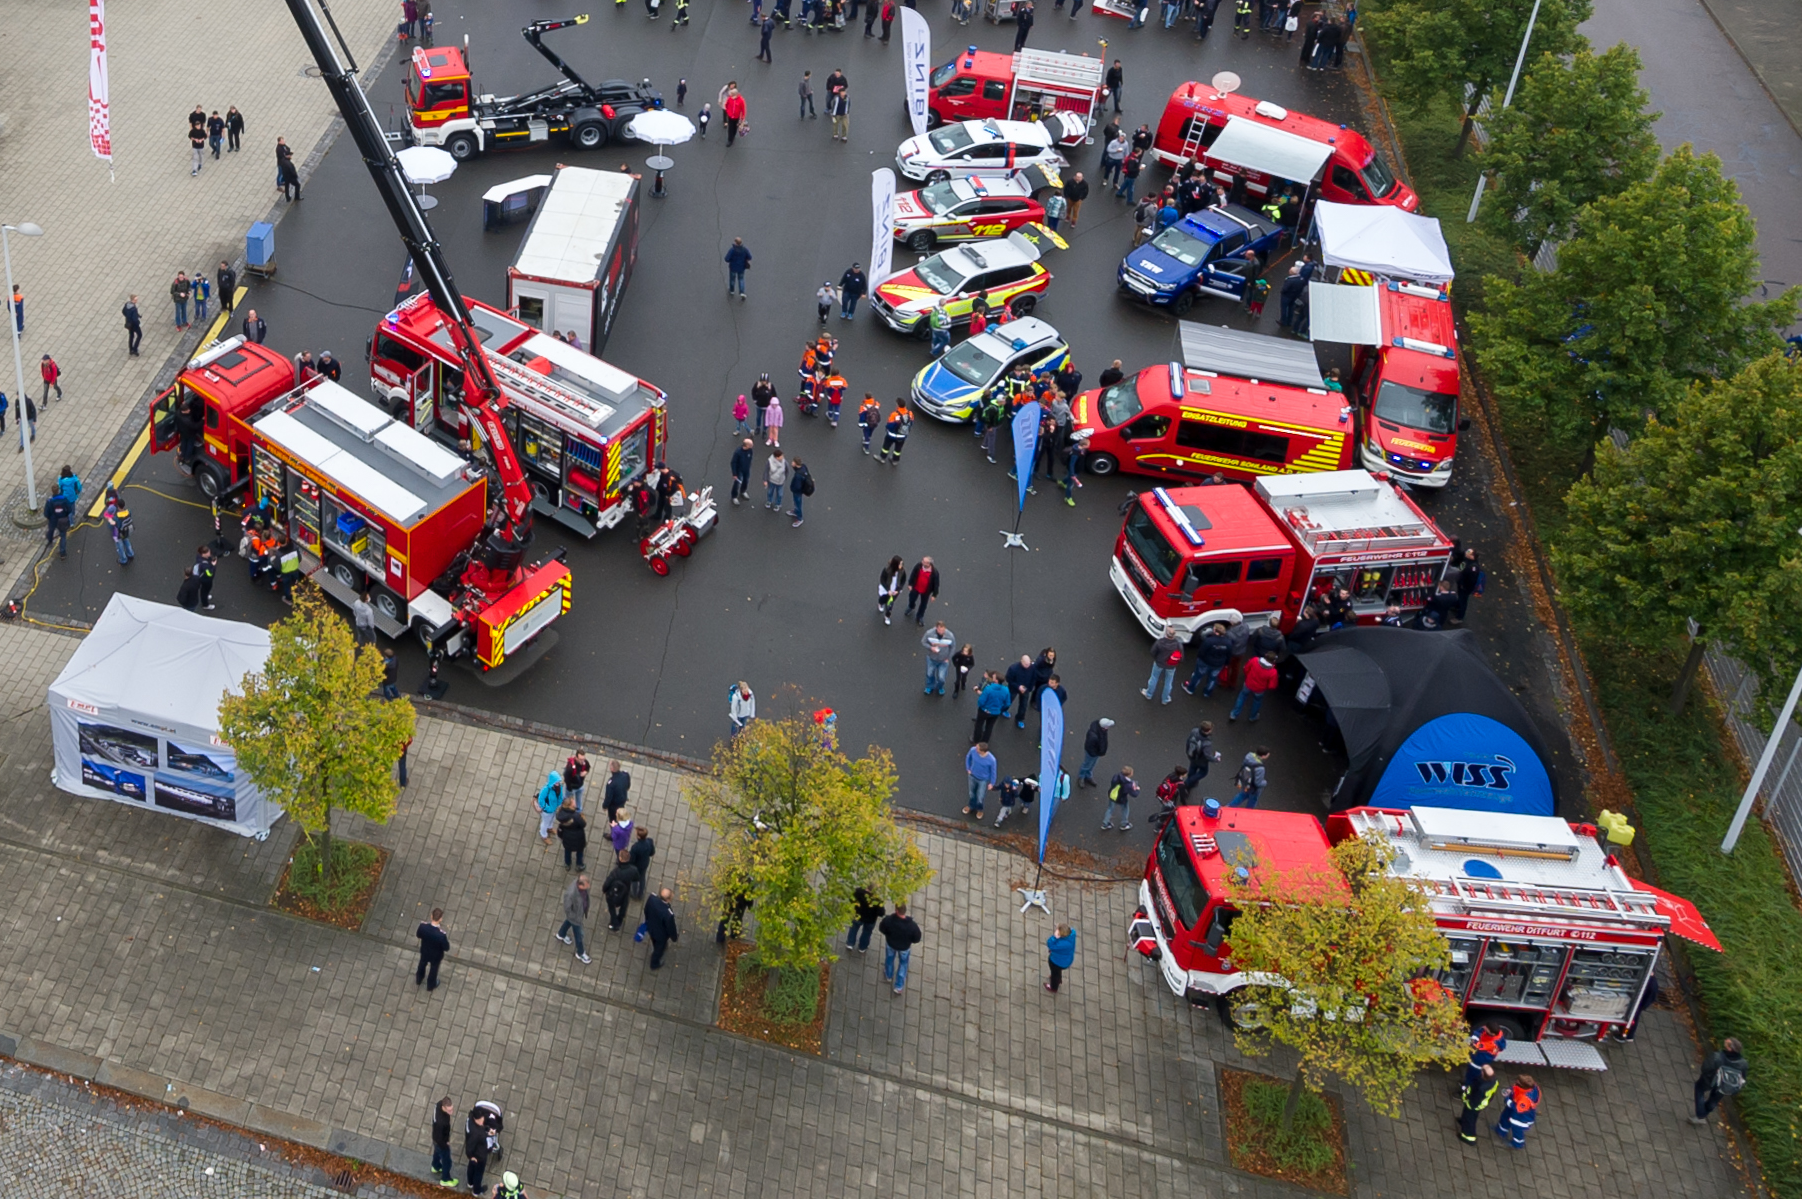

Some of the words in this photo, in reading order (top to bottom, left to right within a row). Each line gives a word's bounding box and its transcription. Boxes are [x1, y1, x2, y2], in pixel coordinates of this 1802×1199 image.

[973, 224, 1007, 236] 112
[1182, 411, 1247, 428] EINSATZLEITUNG
[1191, 452, 1239, 467] FEUERWEHR
[1340, 552, 1403, 563] FEUERWEHR
[1414, 761, 1512, 790] WISS
[1466, 921, 1525, 933] FEUERWEHR
[1526, 926, 1567, 937] DITFURT
